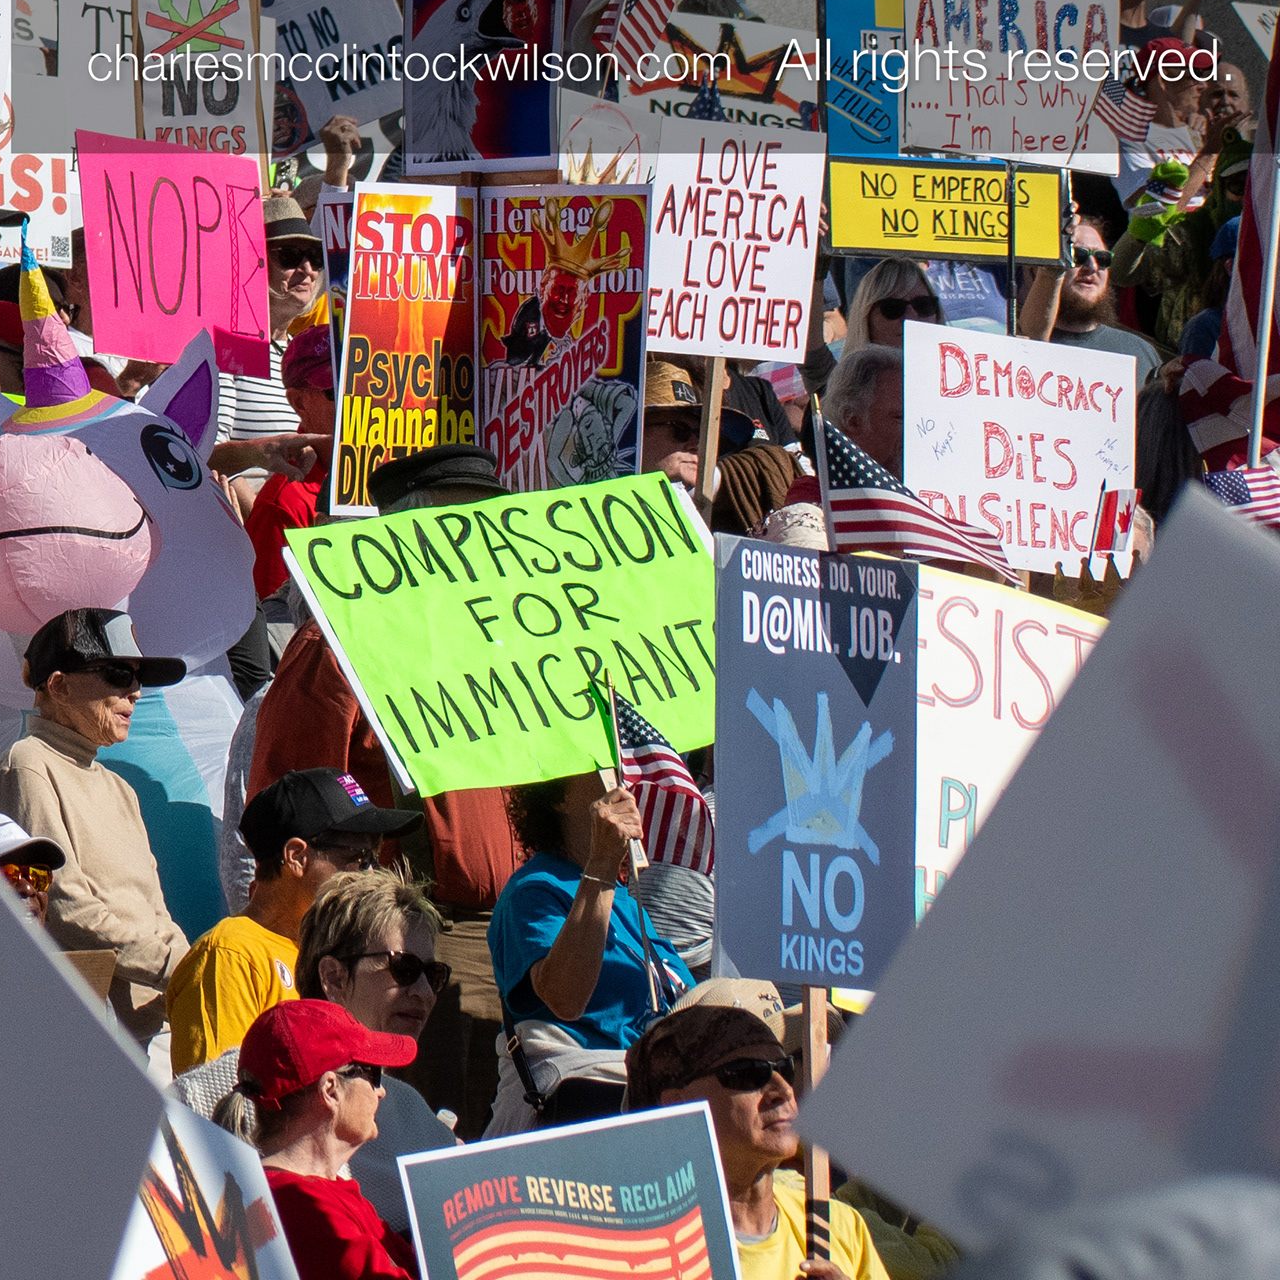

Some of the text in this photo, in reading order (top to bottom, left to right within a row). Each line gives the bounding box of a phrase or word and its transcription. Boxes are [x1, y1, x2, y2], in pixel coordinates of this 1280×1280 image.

[696, 136, 782, 192] LOVE
[860, 170, 897, 199] NO
[355, 210, 474, 255] STOP
[654, 184, 809, 250] AMERICA
[882, 207, 1009, 239] NO KINGS
[353, 251, 473, 303] TRUMP
[682, 239, 771, 294] LOVE
[647, 286, 804, 350] EACH OTHER
[344, 335, 475, 409] Psycho
[484, 319, 610, 471] DESTROYERS
[340, 394, 475, 450] Wannabe
[307, 477, 699, 600] COMPASSION
[741, 547, 902, 601] CONGRESS. DO. YOUR.
[463, 582, 621, 643] FOR
[847, 604, 902, 665] JOB.
[781, 849, 865, 934] NO
[780, 933, 865, 977] KINGS
[442, 1175, 522, 1229] REMOVE
[525, 1175, 617, 1213] REVERSE
[619, 1161, 696, 1213] RECLAIM
